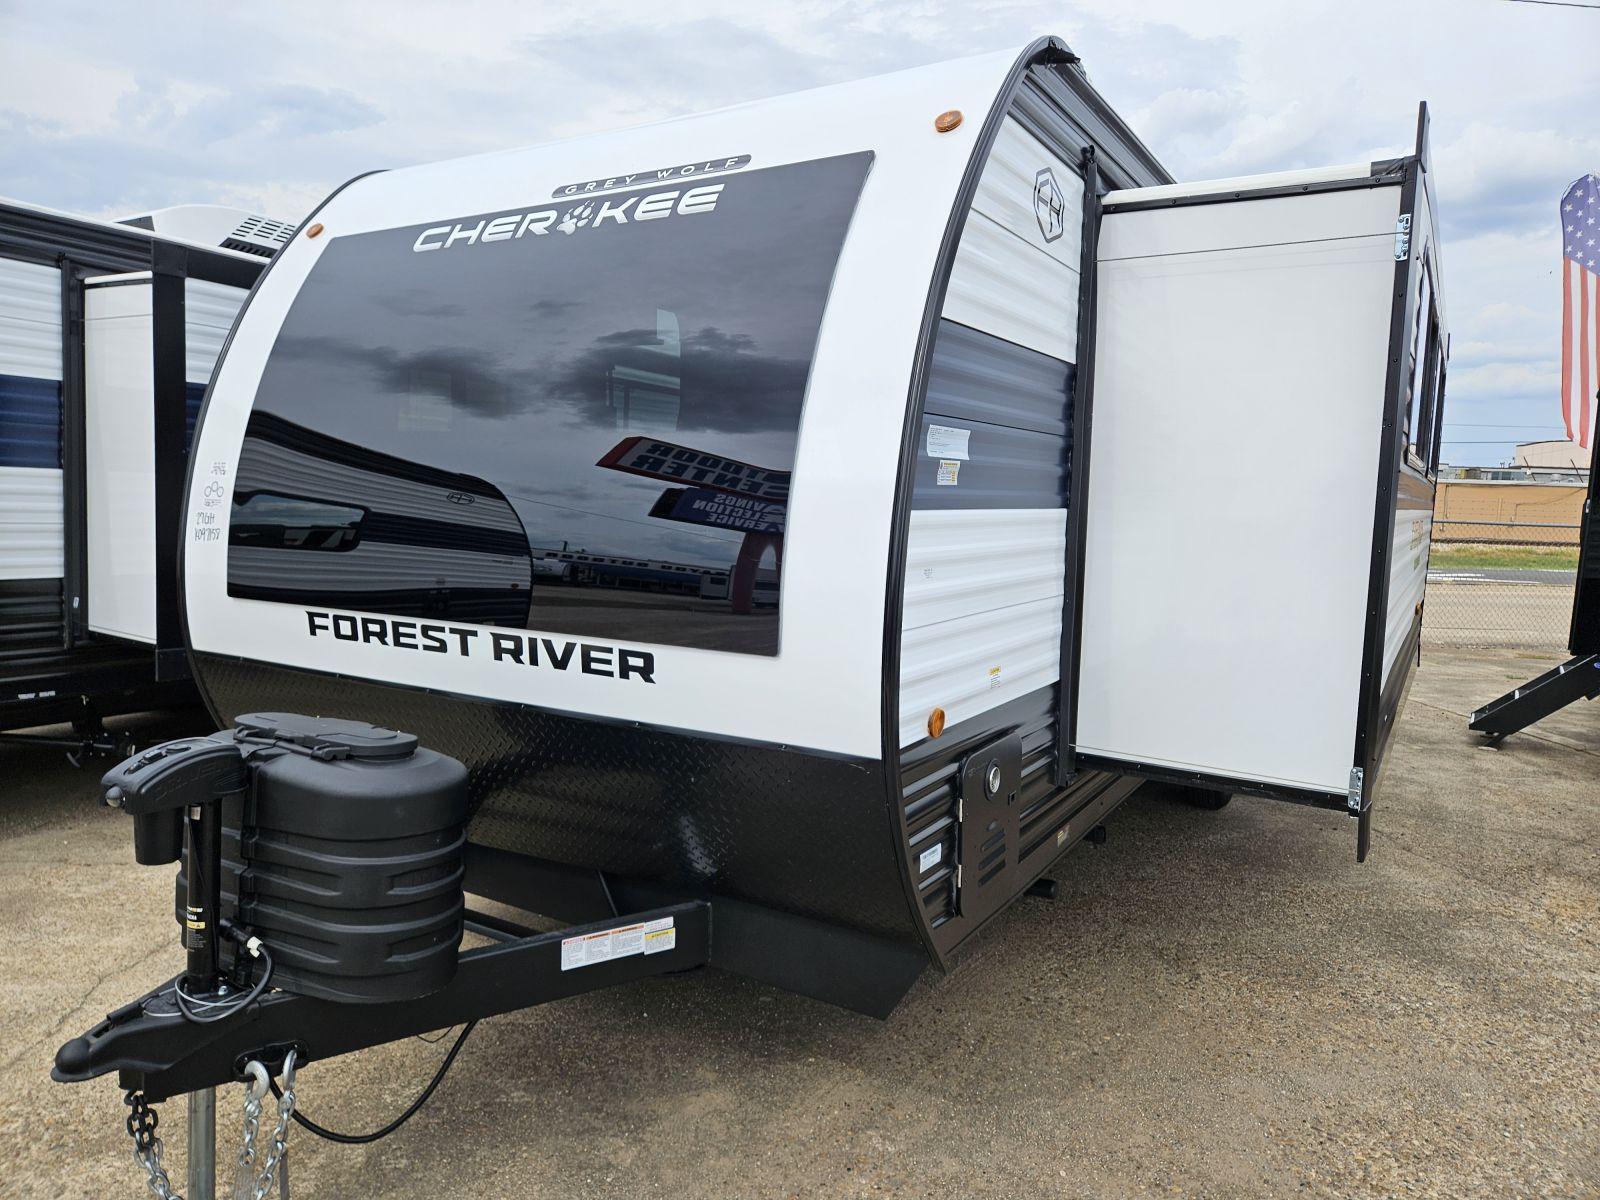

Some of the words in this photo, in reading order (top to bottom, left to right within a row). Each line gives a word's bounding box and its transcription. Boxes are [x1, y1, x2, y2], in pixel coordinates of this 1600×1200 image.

[564, 175, 637, 194] GREY
[656, 157, 739, 179] WOLF
[413, 184, 725, 252] CHEROKEE
[305, 610, 478, 656] FOREST
[489, 632, 656, 684] RIVER
